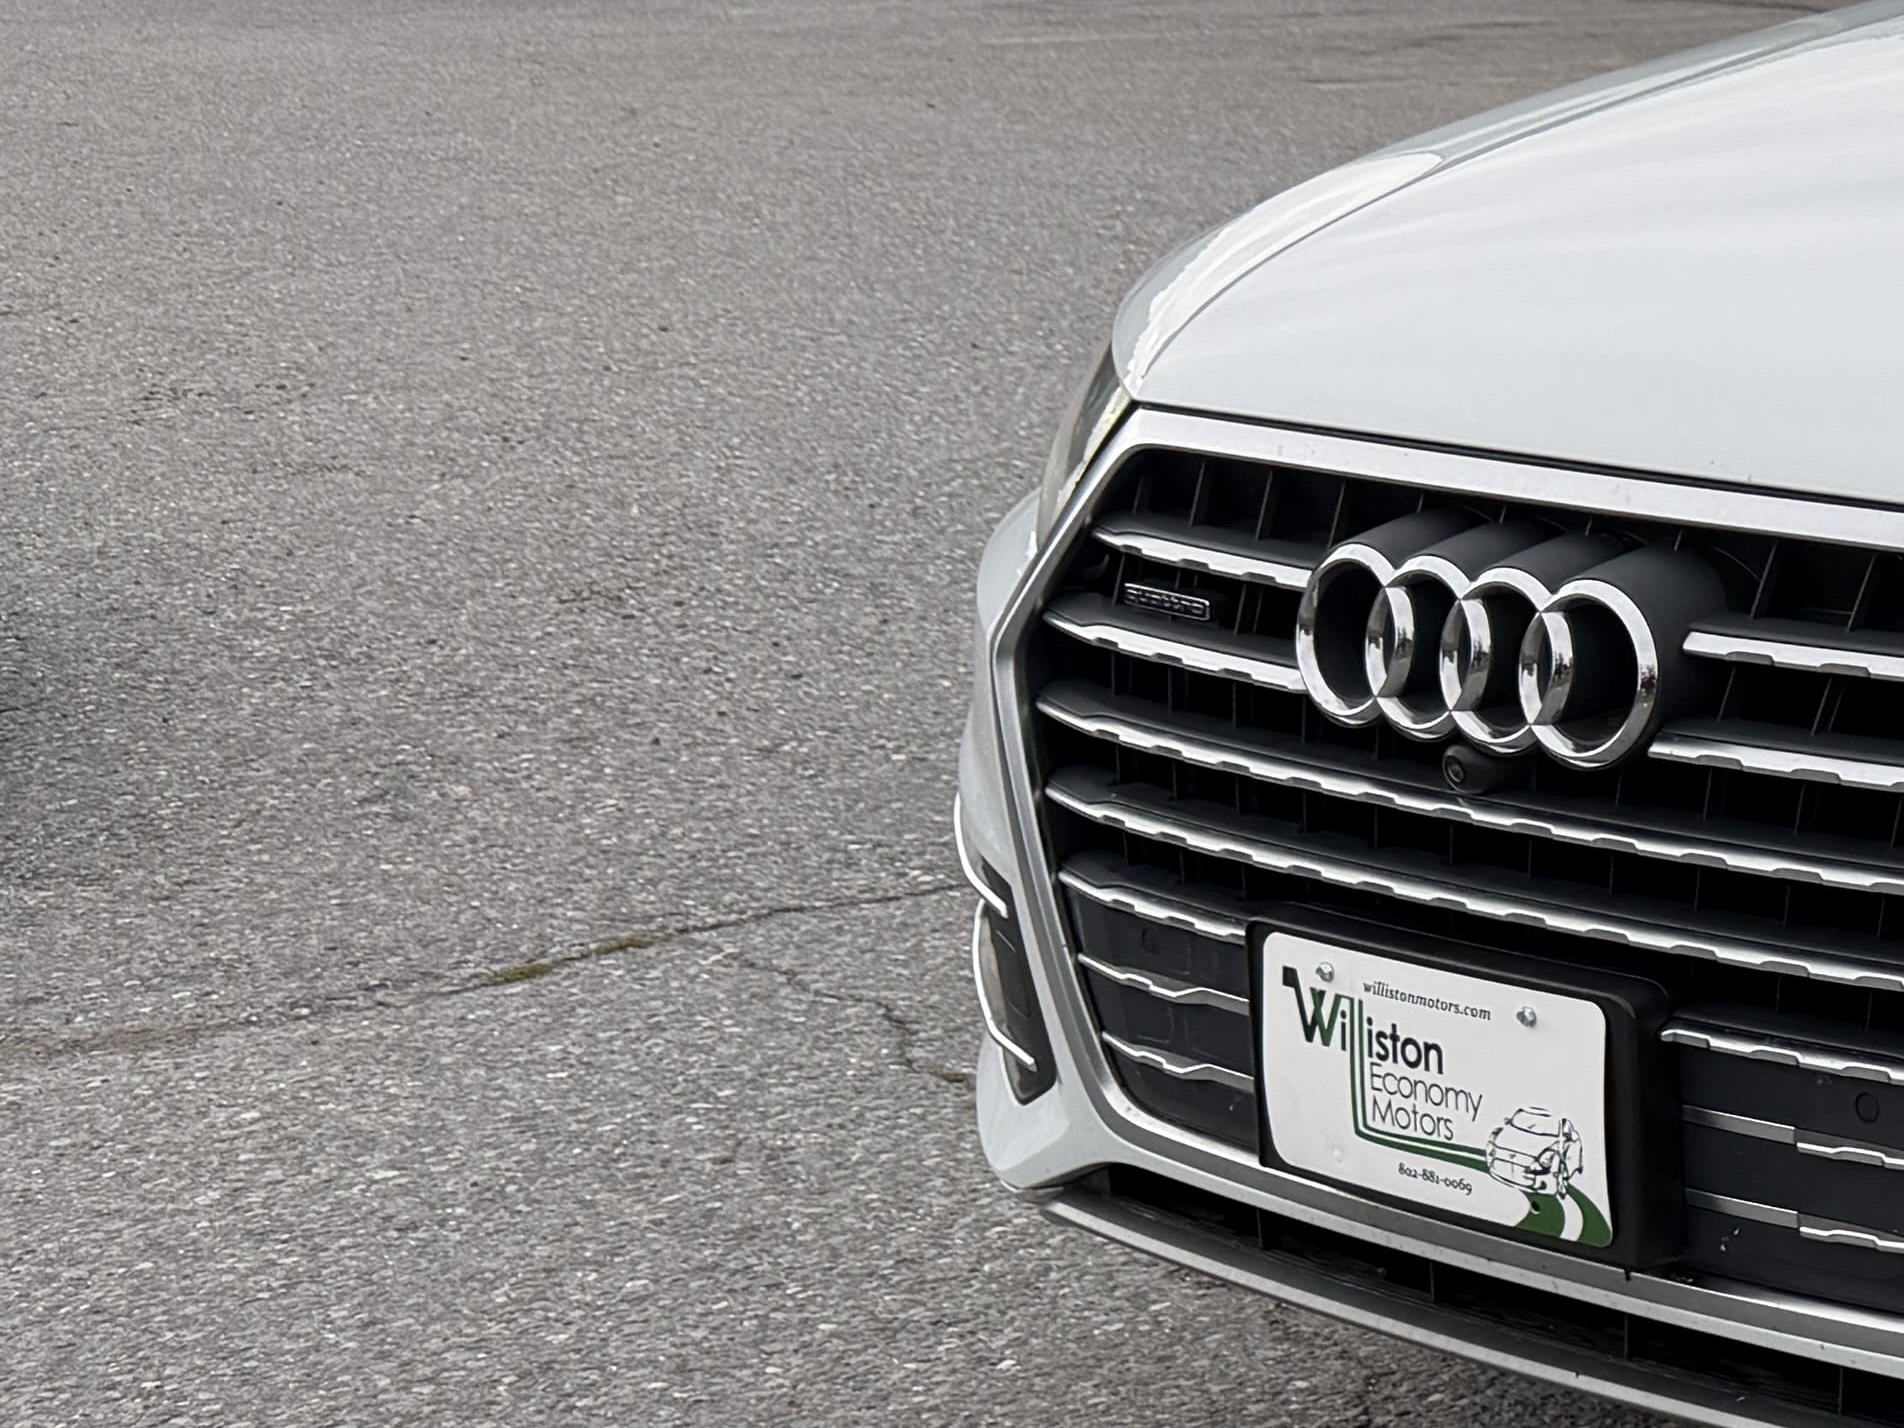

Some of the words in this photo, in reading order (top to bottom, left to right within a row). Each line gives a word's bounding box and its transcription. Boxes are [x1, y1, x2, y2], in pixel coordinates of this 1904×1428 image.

[1282, 965, 1444, 1075] Williston
[1362, 980, 1492, 1021] willistonmotors.com
[1369, 1061, 1484, 1123] Economy
[1371, 1095, 1454, 1142] Motors
[1398, 1162, 1473, 1196] 802-881-0069
